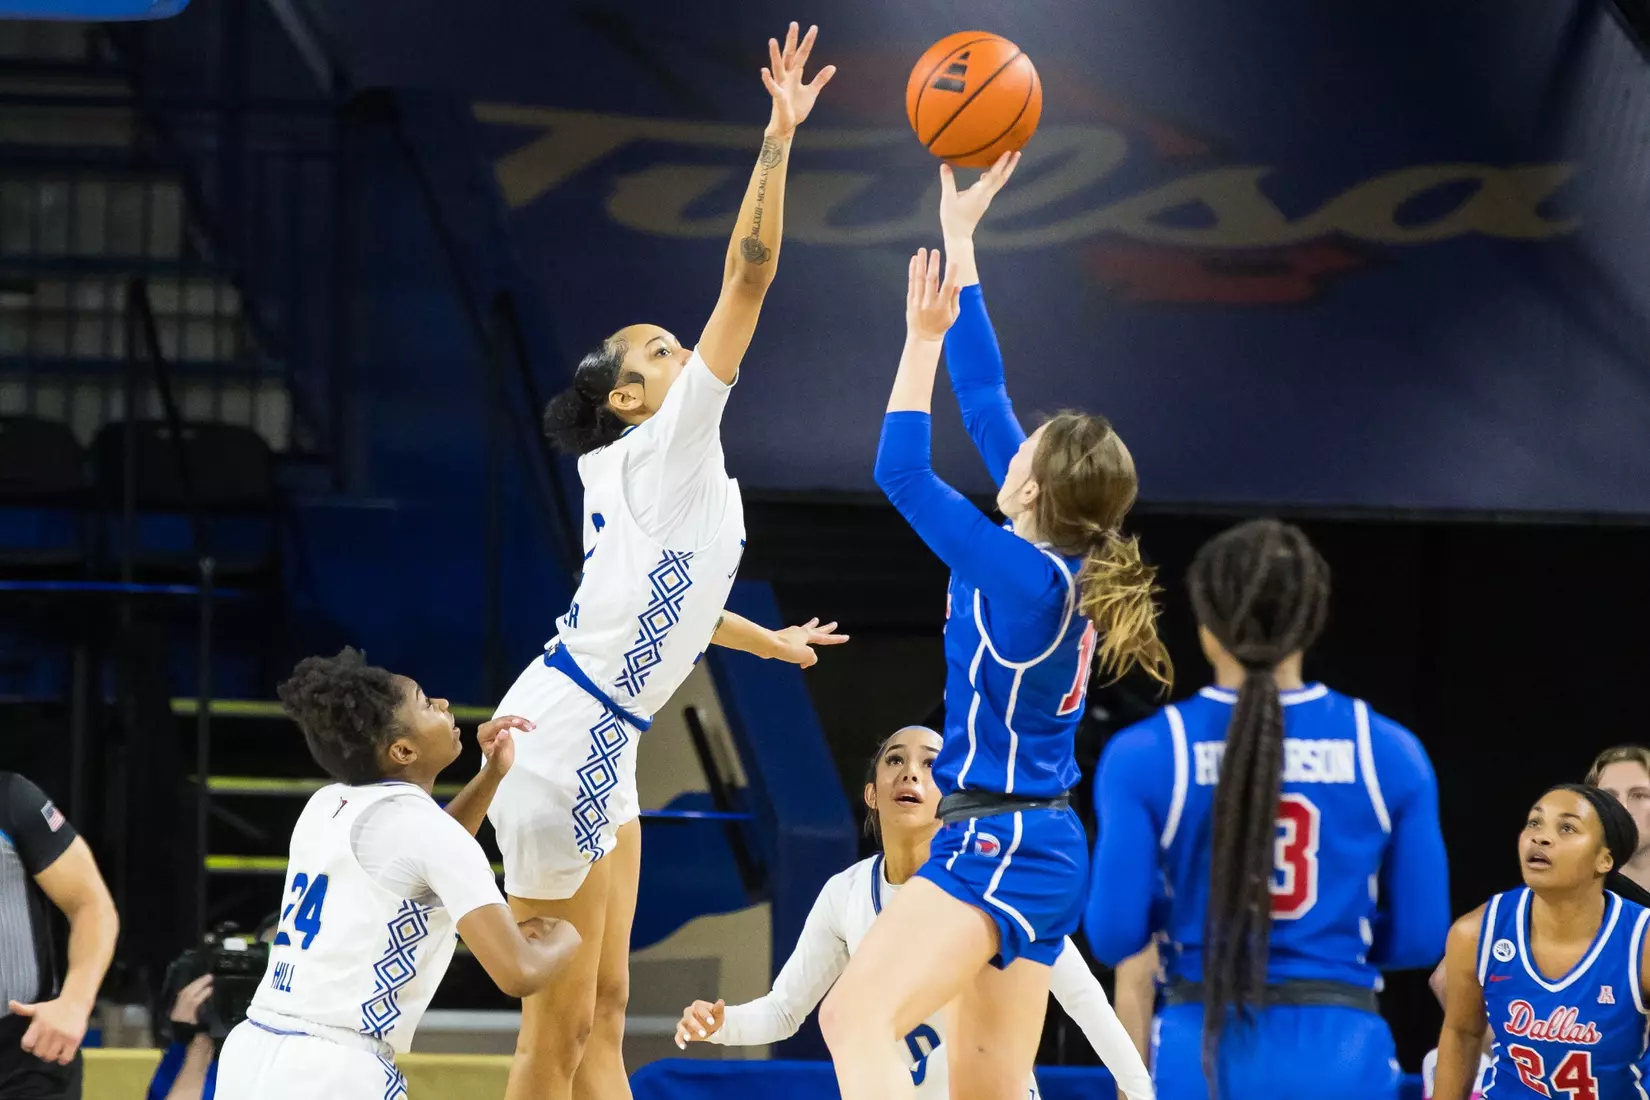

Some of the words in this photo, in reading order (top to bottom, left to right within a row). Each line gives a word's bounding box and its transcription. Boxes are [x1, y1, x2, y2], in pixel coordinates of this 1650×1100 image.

[472, 101, 1582, 249] Tulsa
[1192, 737, 1356, 786] HRSON
[1266, 793, 1321, 920] 3
[273, 871, 329, 950] 24
[271, 960, 296, 993] HILL
[1503, 999, 1602, 1045] Dallas
[1507, 1043, 1600, 1100] 24
